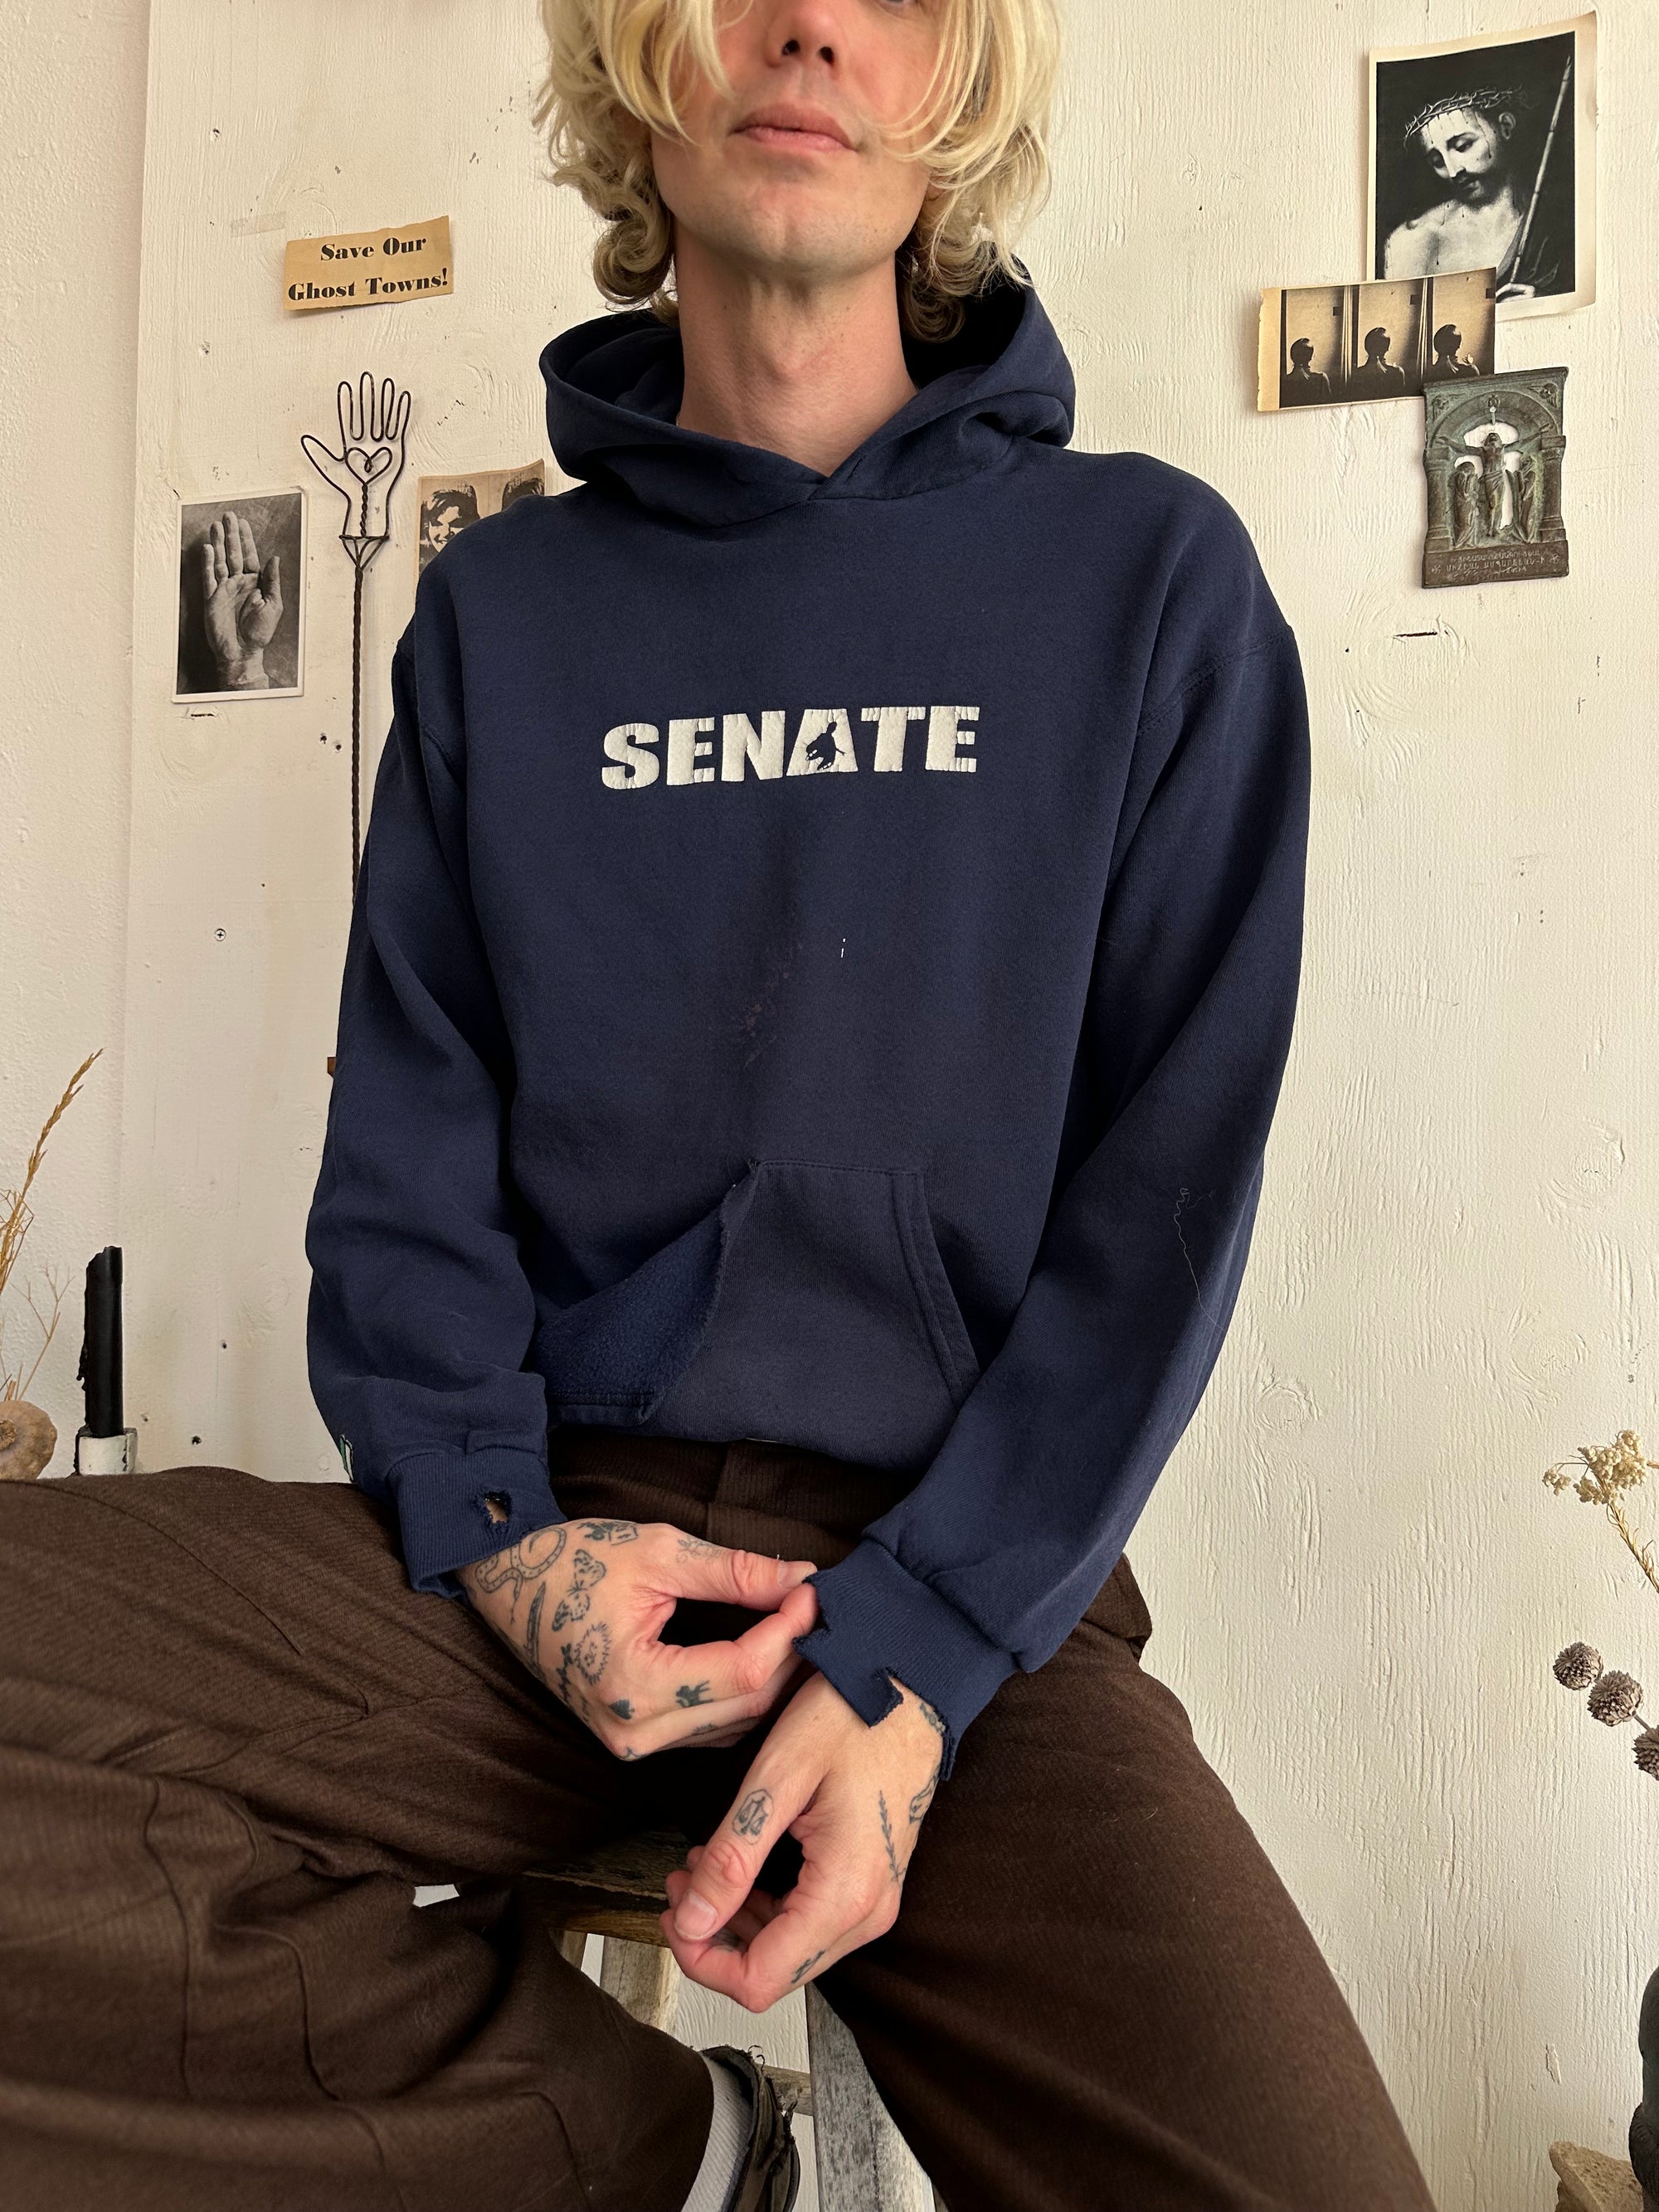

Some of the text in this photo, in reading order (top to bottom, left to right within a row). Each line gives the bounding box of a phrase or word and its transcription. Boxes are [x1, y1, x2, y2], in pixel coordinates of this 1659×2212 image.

[320, 237, 427, 261] Save Our
[288, 267, 448, 301] Ghost Towns!
[601, 705, 980, 790] SENATE
